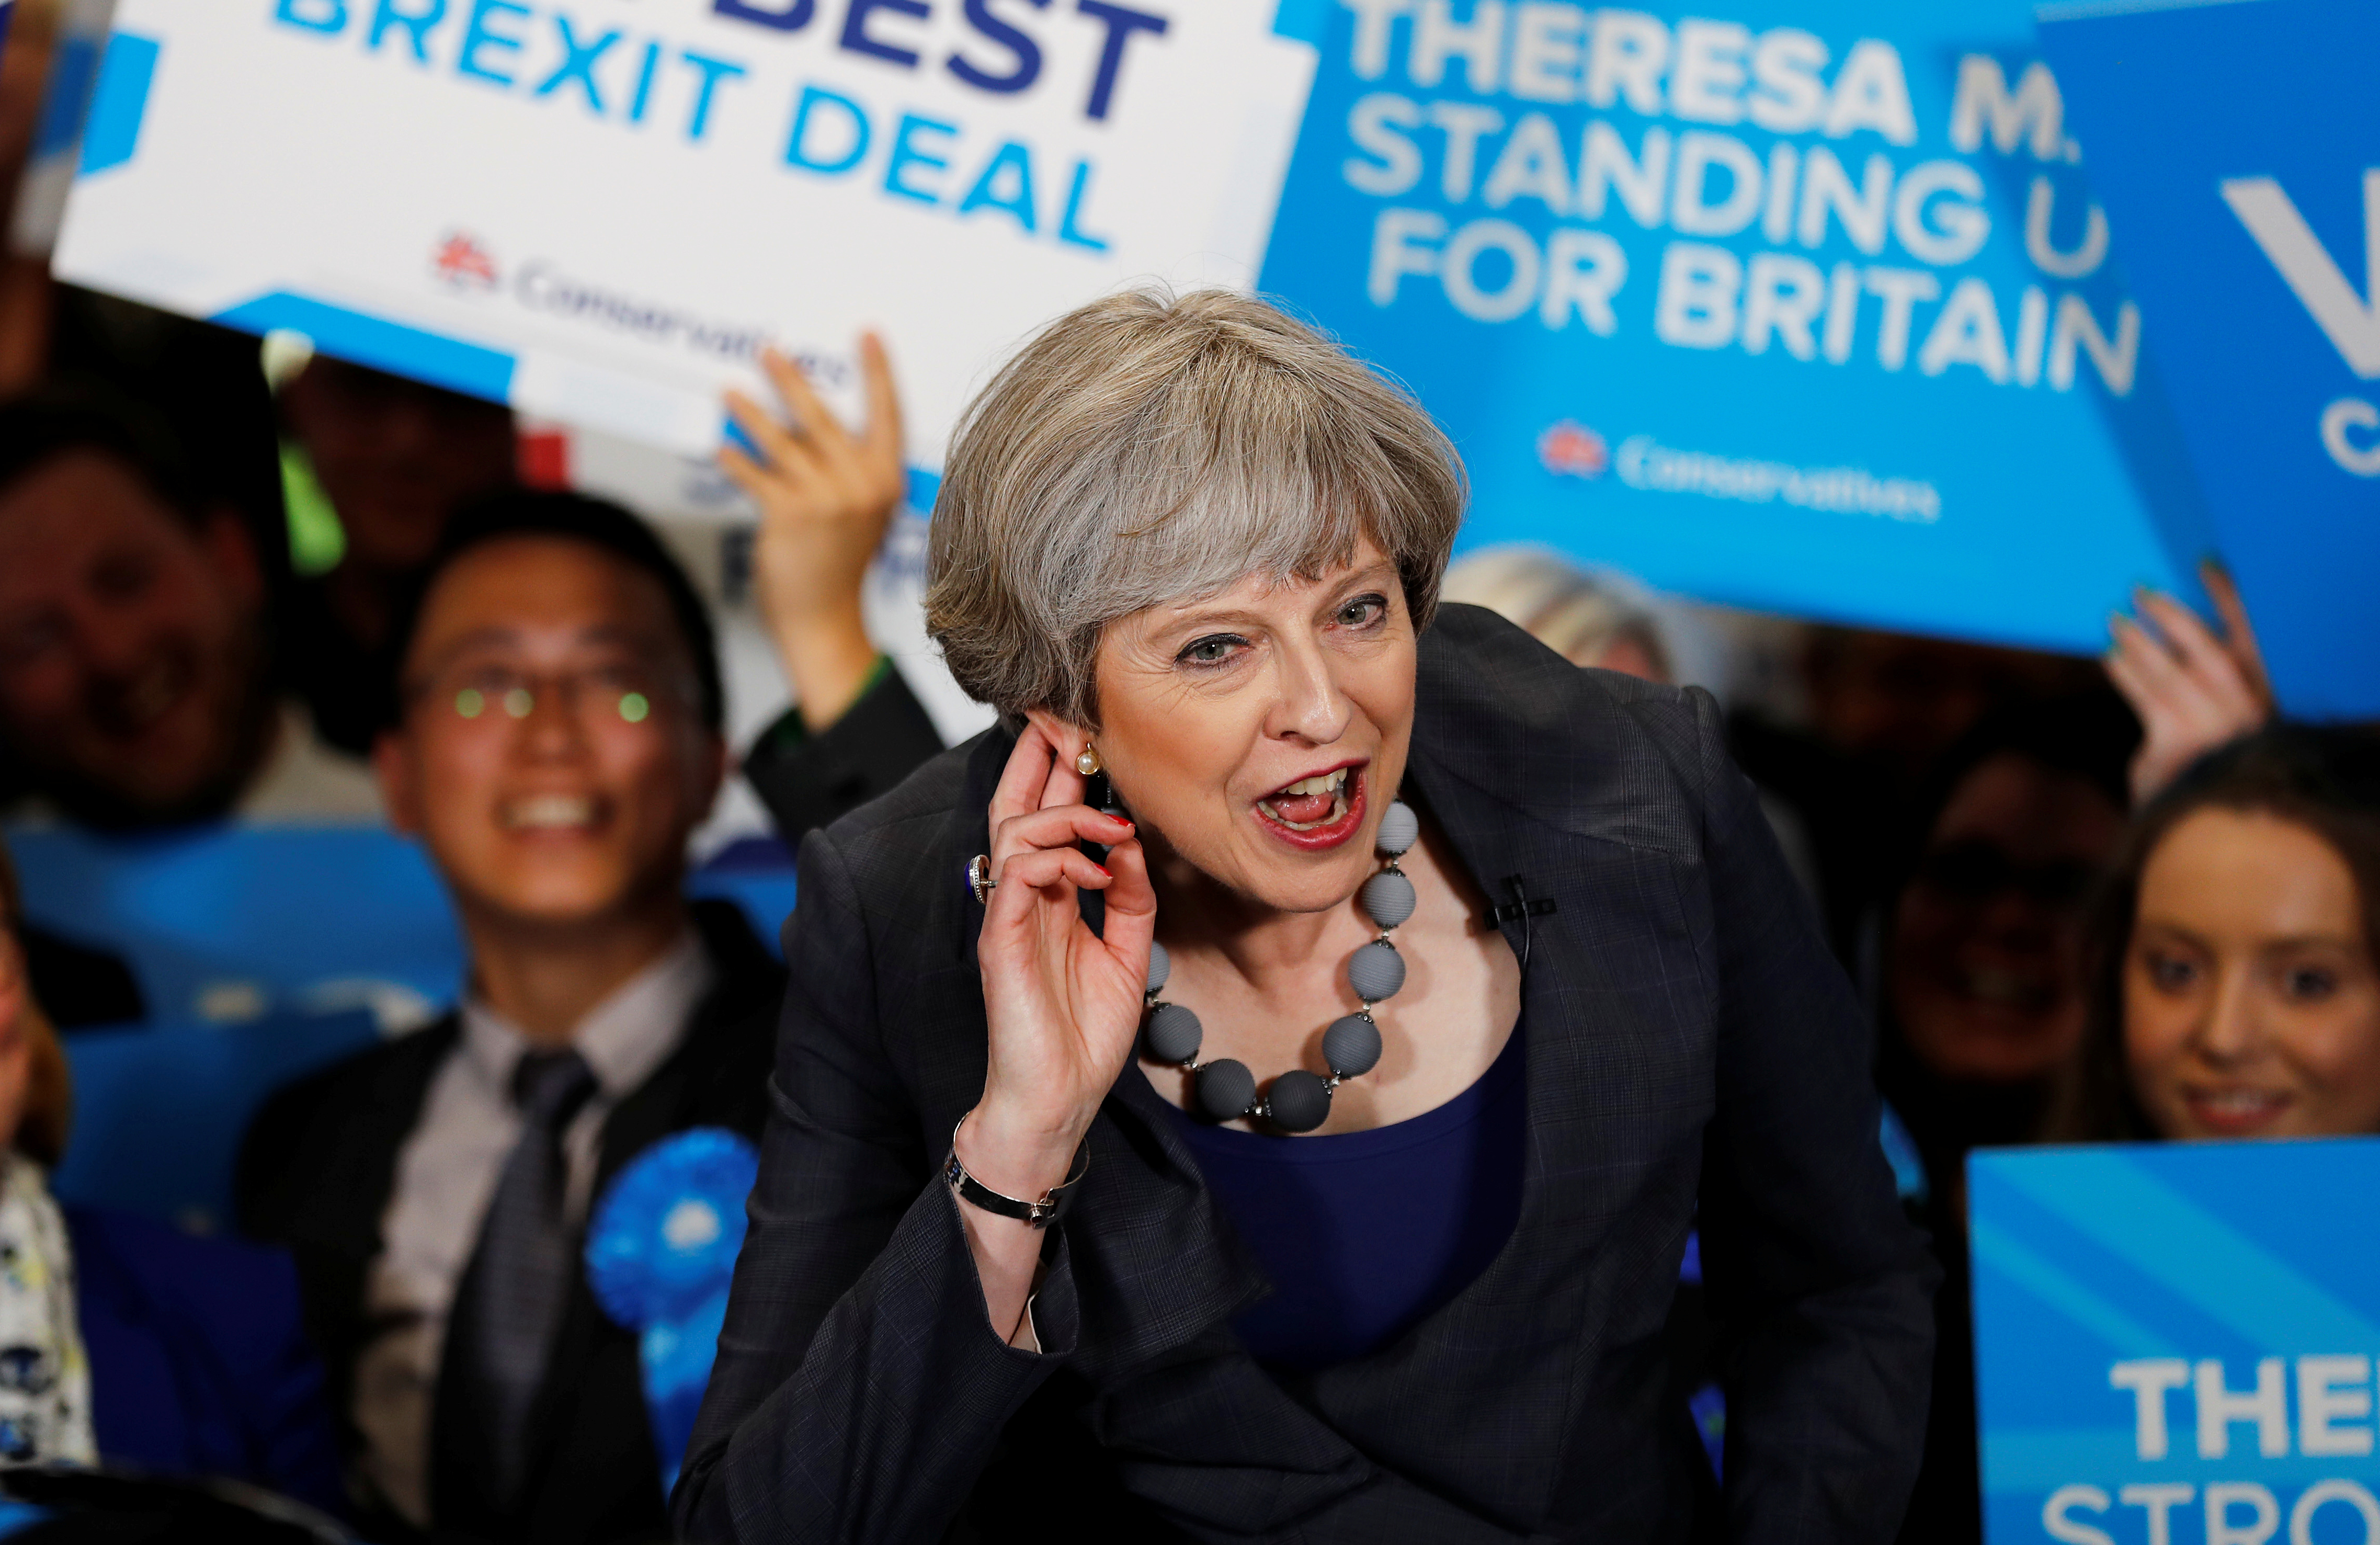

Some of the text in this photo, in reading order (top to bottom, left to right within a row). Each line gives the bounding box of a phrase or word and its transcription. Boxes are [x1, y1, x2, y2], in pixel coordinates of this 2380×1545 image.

[1340, 0, 2081, 165] THERESA M
[782, 83, 1113, 256] DEAL
[1342, 92, 1990, 266] STANDING
[1366, 208, 2142, 397] FOR BRITAIN
[2109, 1355, 2380, 1461] THE
